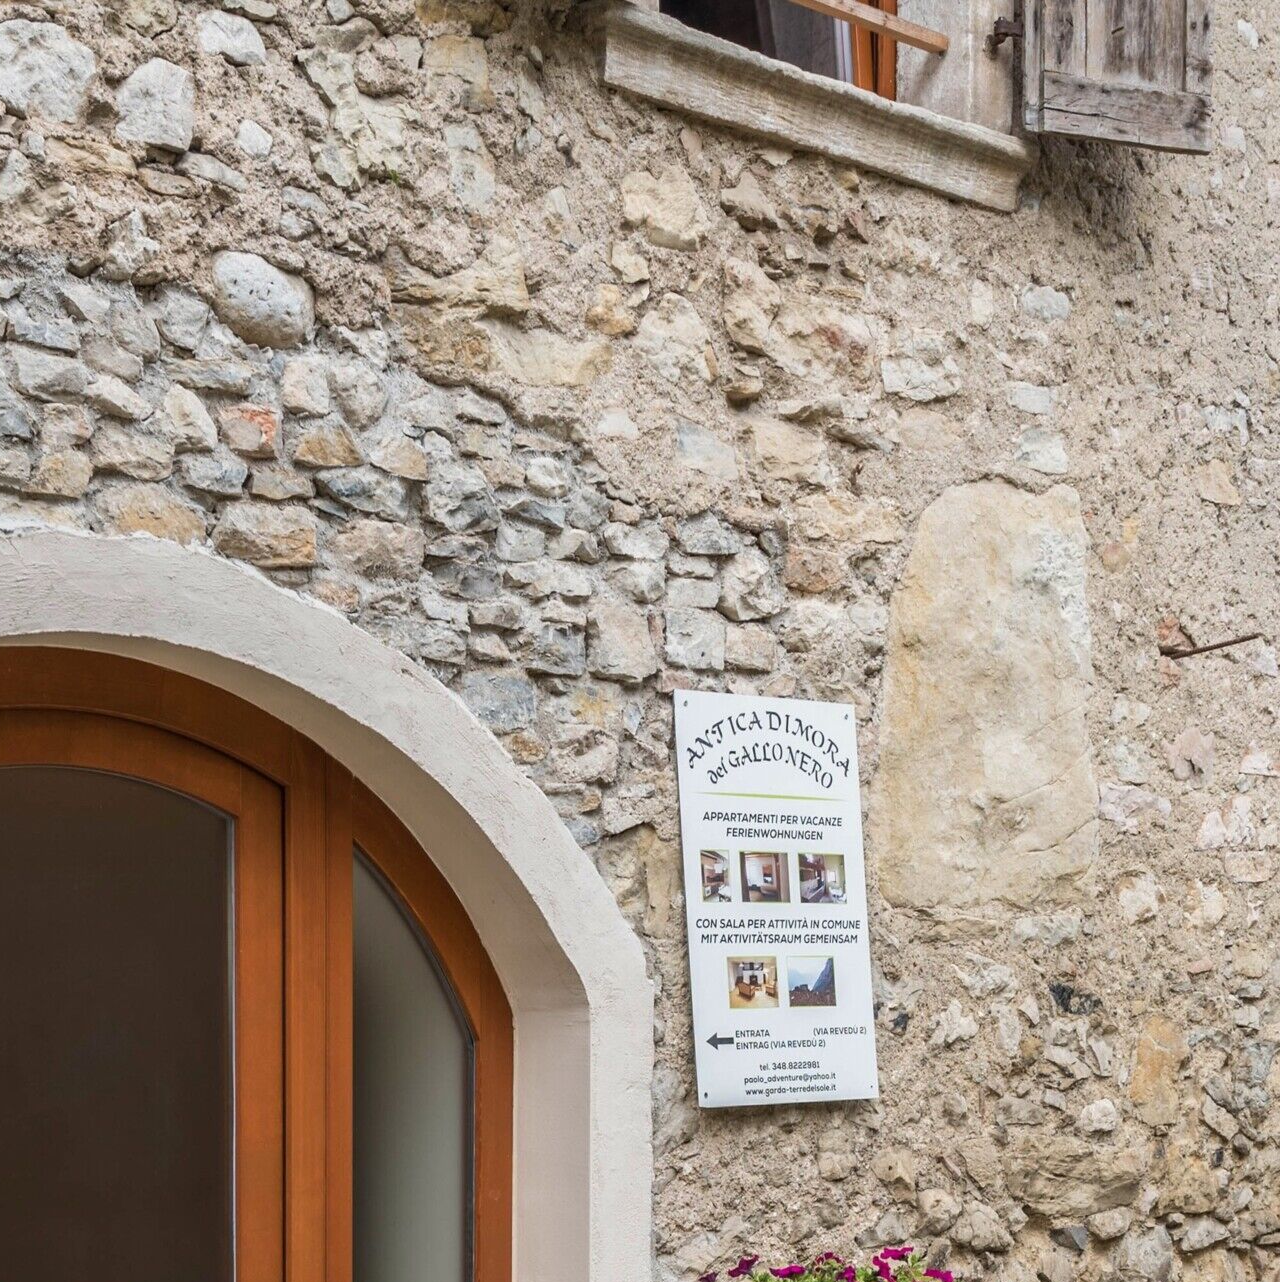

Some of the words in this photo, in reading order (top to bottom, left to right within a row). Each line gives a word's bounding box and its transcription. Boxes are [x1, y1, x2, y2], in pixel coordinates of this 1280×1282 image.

[686, 711, 763, 769] ANTICA
[765, 710, 851, 777] DIMORA
[728, 742, 783, 770] GALLO
[785, 746, 833, 789] NERO
[702, 811, 778, 824] APPARTAMENTI
[780, 814, 798, 825] PER
[800, 815, 843, 827] VACANZE
[726, 827, 824, 841] FERIENWOHNUNGEN
[695, 918, 718, 929] CON
[719, 918, 745, 929] SALA
[747, 918, 767, 929] PER
[768, 917, 809, 929] ATTIVITÀ
[810, 919, 820, 929] IN
[821, 919, 861, 930] COMUNE
[700, 934, 718, 944] MIT
[719, 931, 802, 944] AKTIVITÄTSRAUM
[803, 934, 858, 944] GEMEINSAM
[735, 1029, 770, 1038] ENTRATA
[813, 1027, 829, 1037] (VIA
[859, 1026, 867, 1036] 2)
[736, 1041, 769, 1050] EINTRAG
[770, 1040, 786, 1050] (VIA
[818, 1039, 826, 1048] 2)
[759, 1062, 770, 1071] tel.
[772, 1061, 820, 1071] 348.8222981
[744, 1072, 836, 1086] paolo_adventure@yahoo.it
